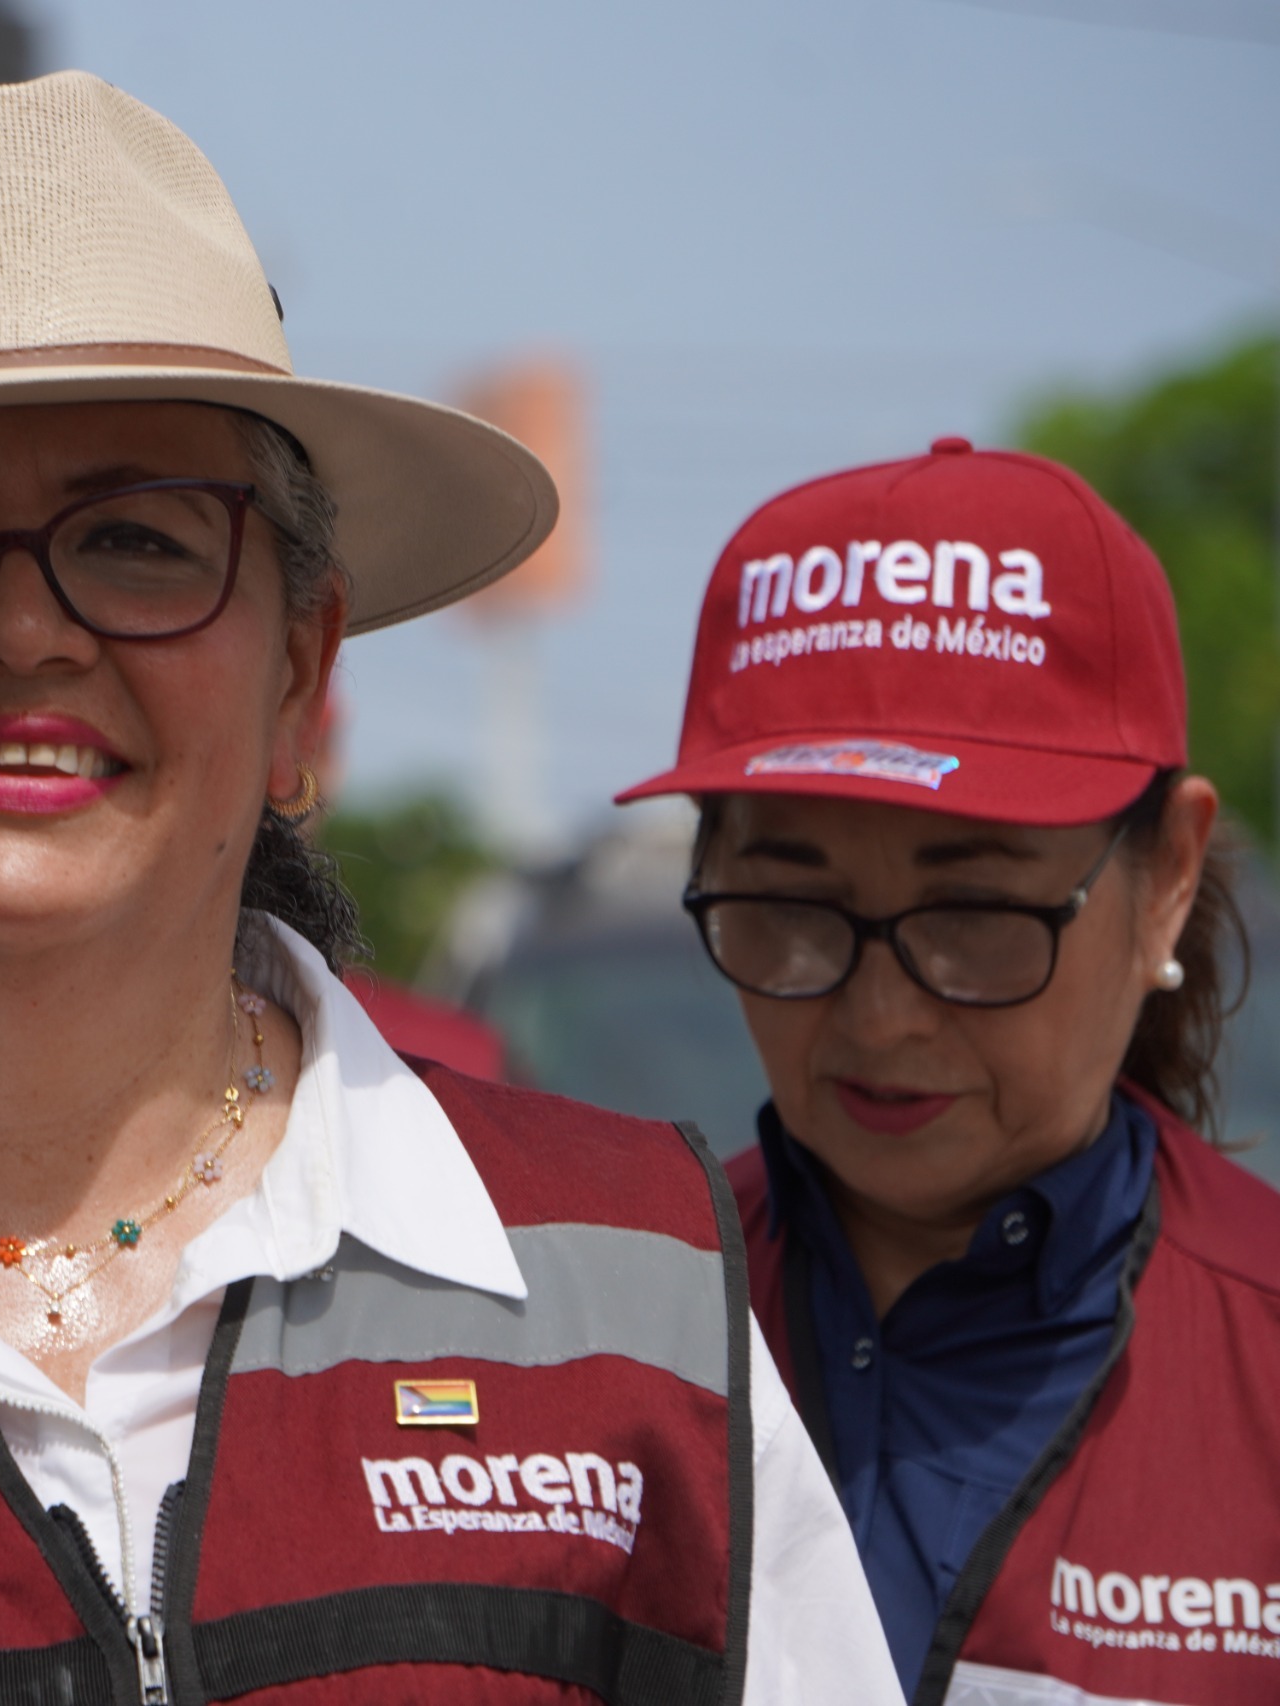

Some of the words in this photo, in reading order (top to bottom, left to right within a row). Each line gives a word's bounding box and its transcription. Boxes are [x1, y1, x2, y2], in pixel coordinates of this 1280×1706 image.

[738, 539, 1051, 629] morena
[751, 618, 882, 667] esperanza
[890, 613, 931, 651] de
[935, 614, 1045, 667] México
[361, 1452, 644, 1524] morena
[374, 1506, 412, 1532] La
[411, 1505, 549, 1535] Esperanza
[546, 1503, 580, 1535] de
[1050, 1609, 1070, 1635] La
[1073, 1620, 1181, 1649] esperanza
[1185, 1627, 1217, 1651] de
[1223, 1629, 1280, 1660] Méxi
